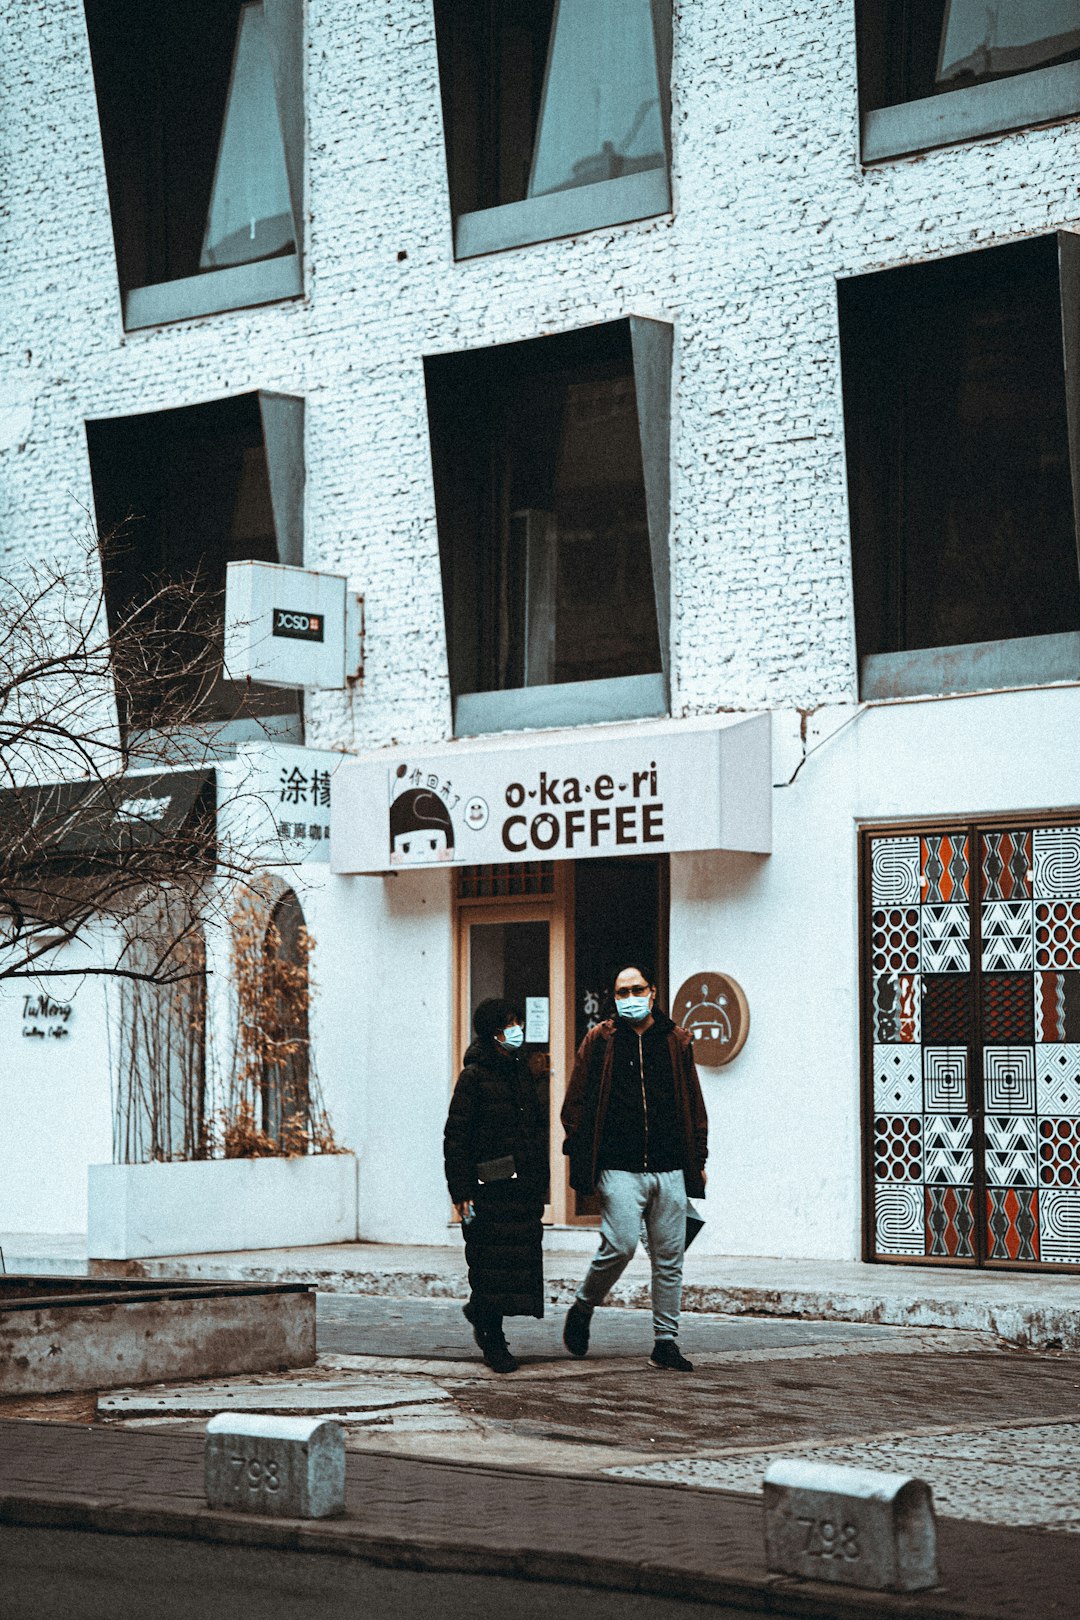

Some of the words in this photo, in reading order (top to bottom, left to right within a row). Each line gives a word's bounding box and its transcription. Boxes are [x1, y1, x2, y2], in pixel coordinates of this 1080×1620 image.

[502, 803, 664, 853] COFFEE
[230, 1455, 280, 1494] 798
[797, 1516, 860, 1562] 798
